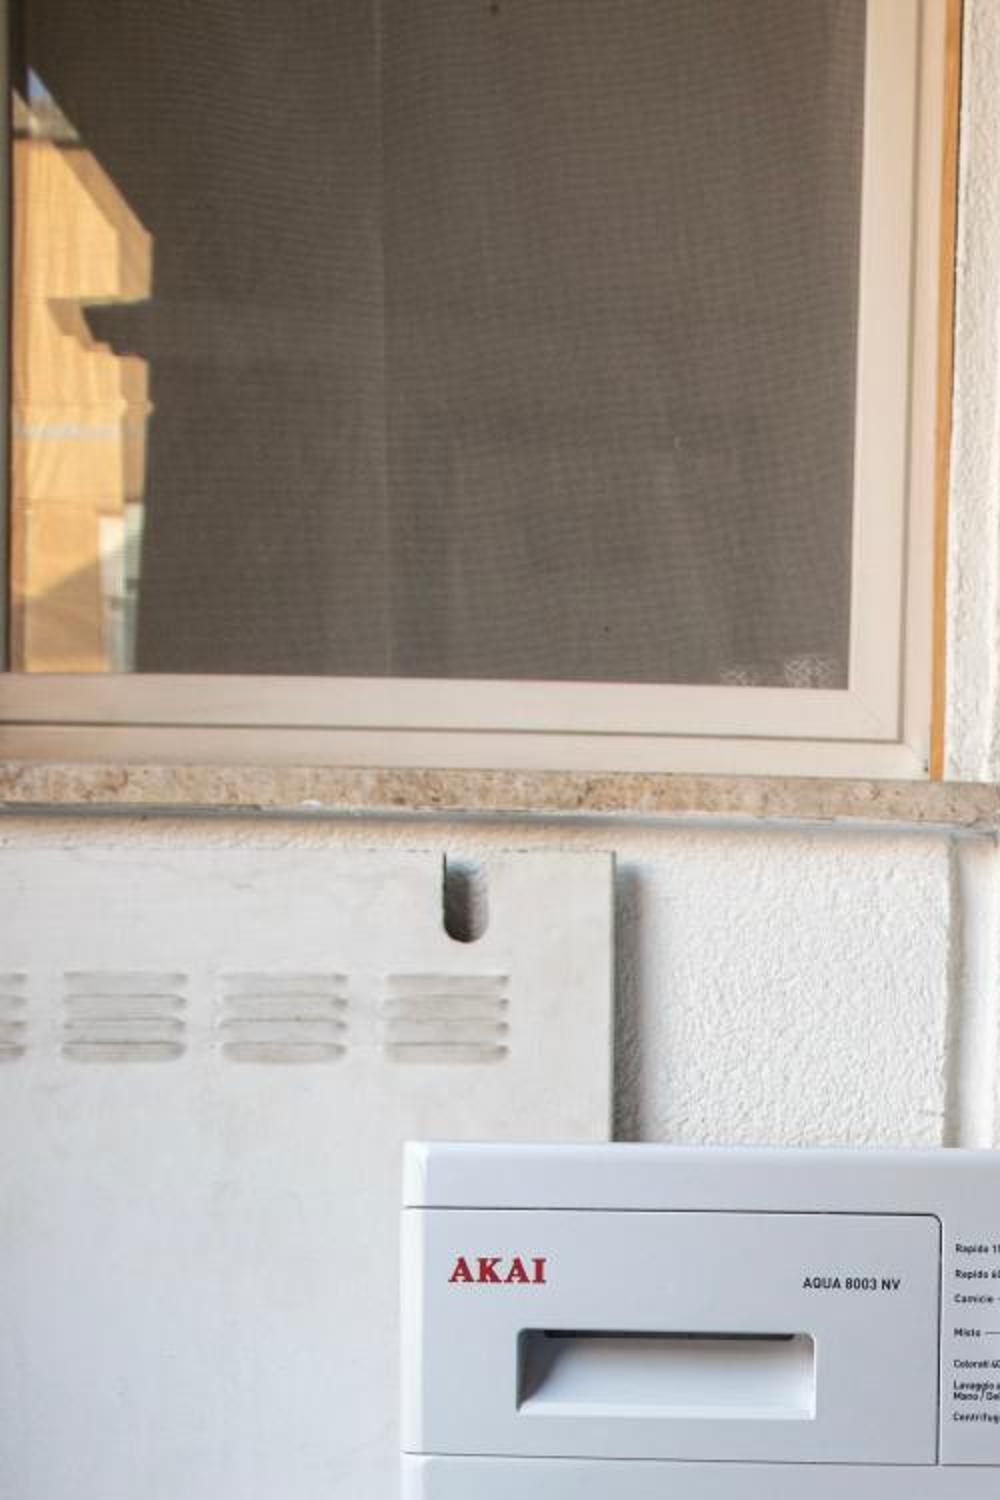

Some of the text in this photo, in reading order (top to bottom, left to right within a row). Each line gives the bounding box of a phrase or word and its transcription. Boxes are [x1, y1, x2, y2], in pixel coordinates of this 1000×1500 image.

[955, 1243, 989, 1256] Rapido
[447, 1257, 547, 1285] AKAI
[955, 1269, 989, 1280] Rapido
[802, 1276, 901, 1291] AQUA 8003 NV
[954, 1293, 994, 1304] Camicie
[953, 1360, 988, 1369] Colorati
[953, 1380, 994, 1391] Lavaggio
[953, 1392, 979, 1401] Mano
